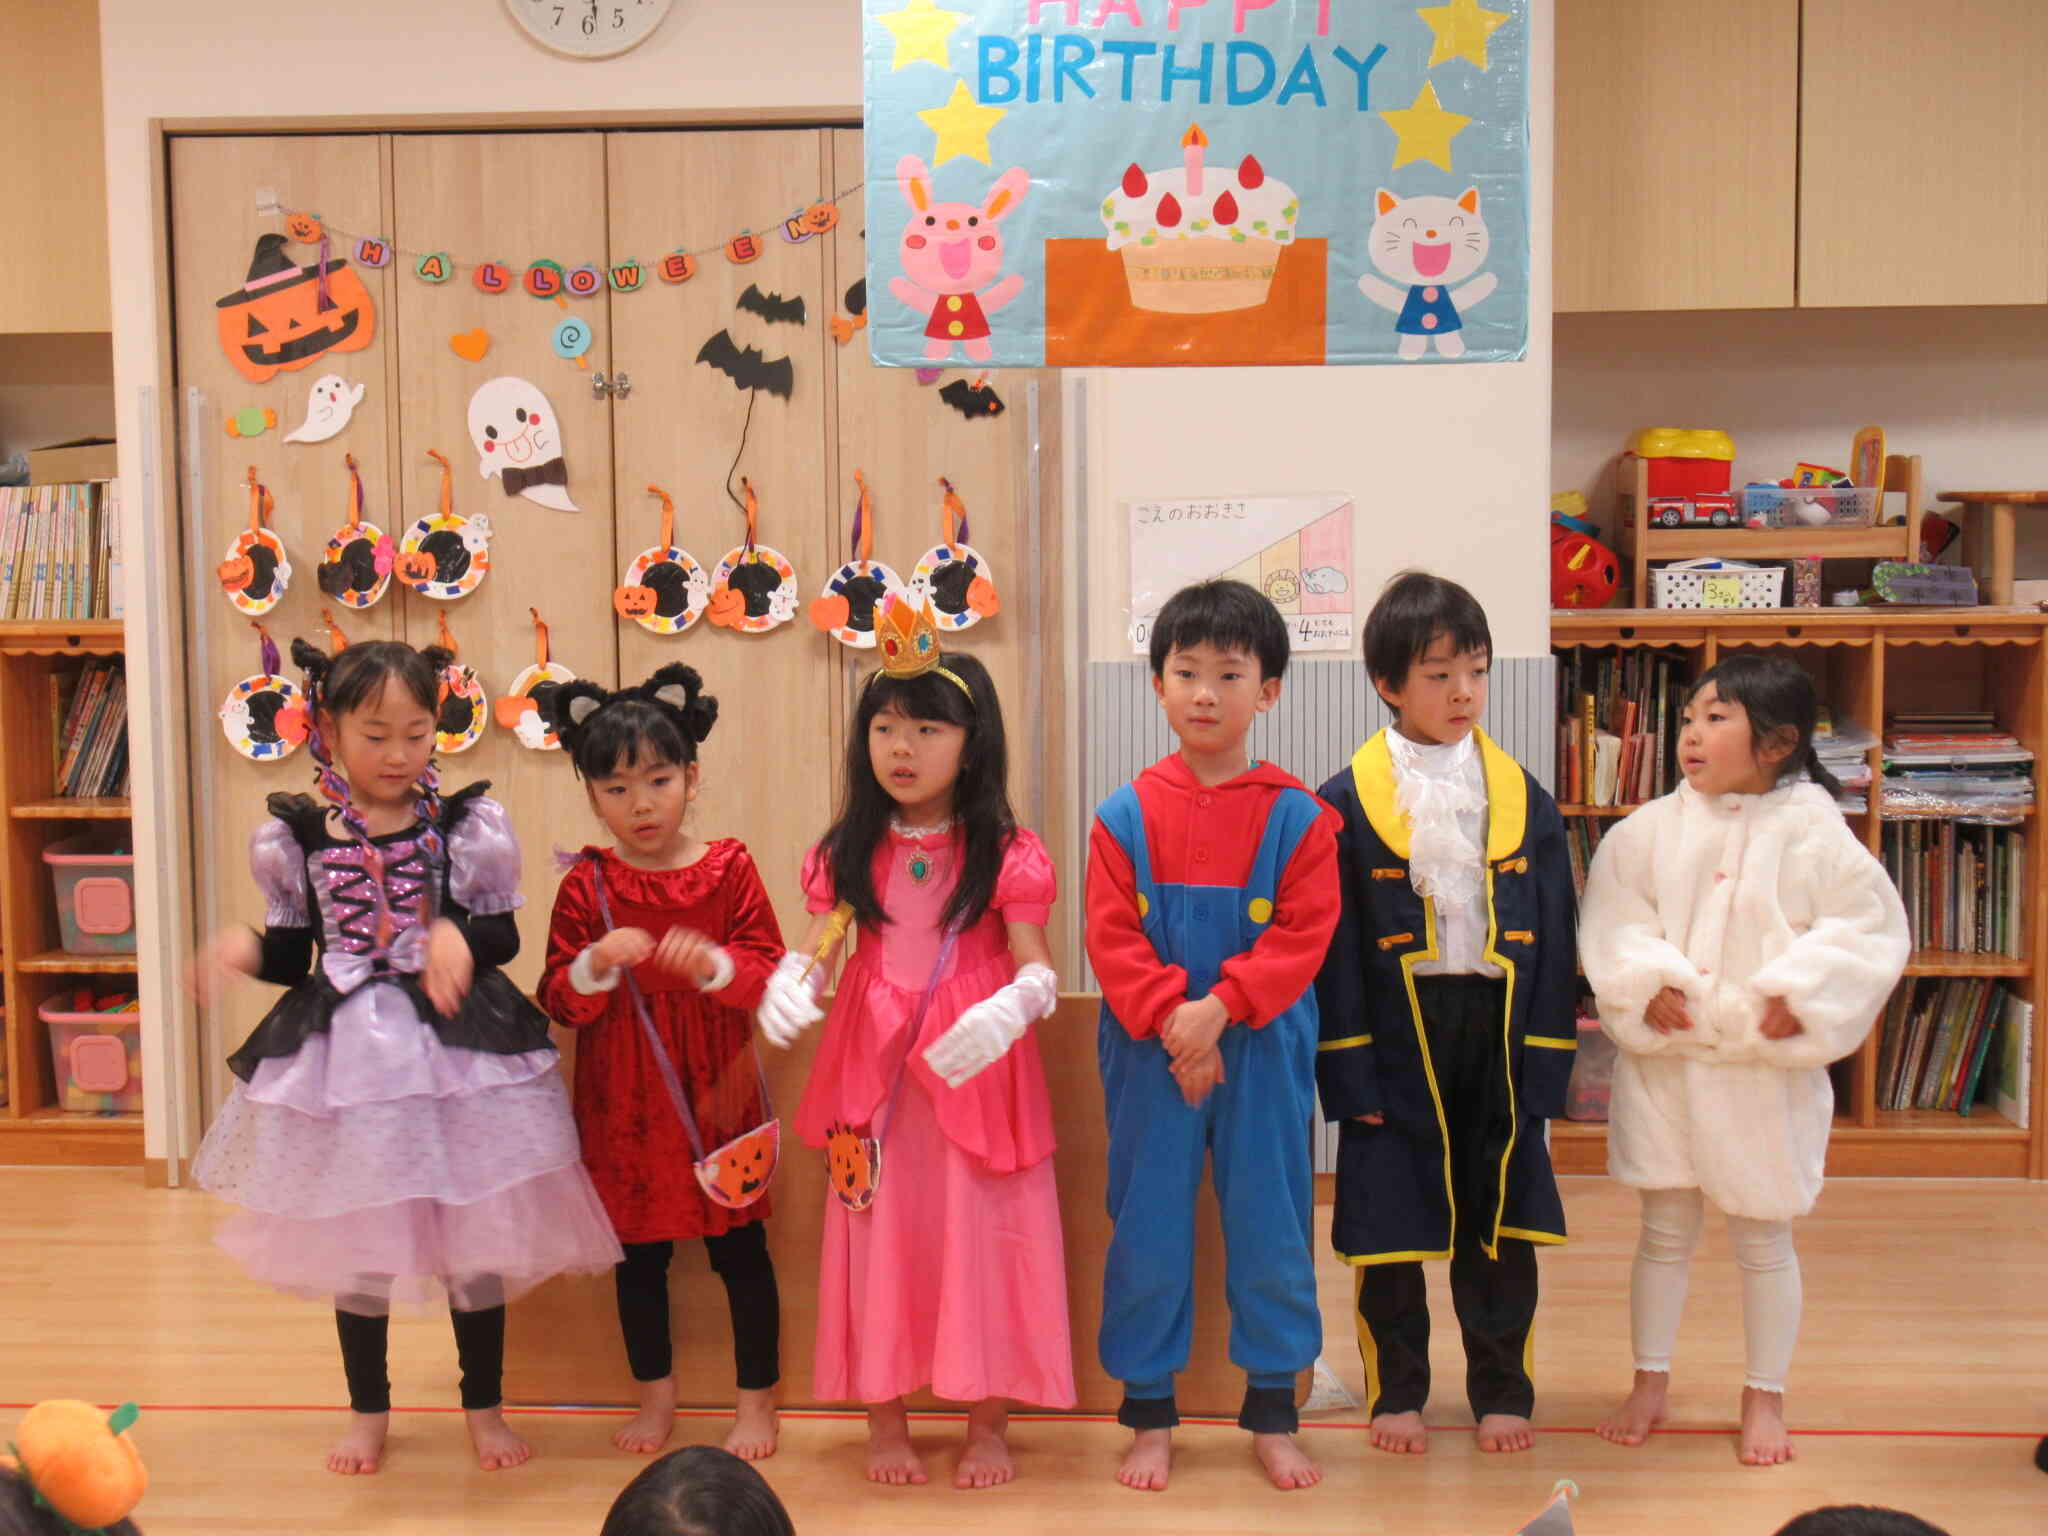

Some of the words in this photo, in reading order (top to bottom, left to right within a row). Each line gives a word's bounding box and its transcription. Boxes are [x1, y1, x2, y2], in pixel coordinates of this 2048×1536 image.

[552, 6, 564, 26] 7
[581, 15, 595, 35] 6
[612, 8, 625, 28] 5
[977, 33, 1388, 112] BIRTHDAY
[1137, 502, 1248, 524] こえのおおきさ
